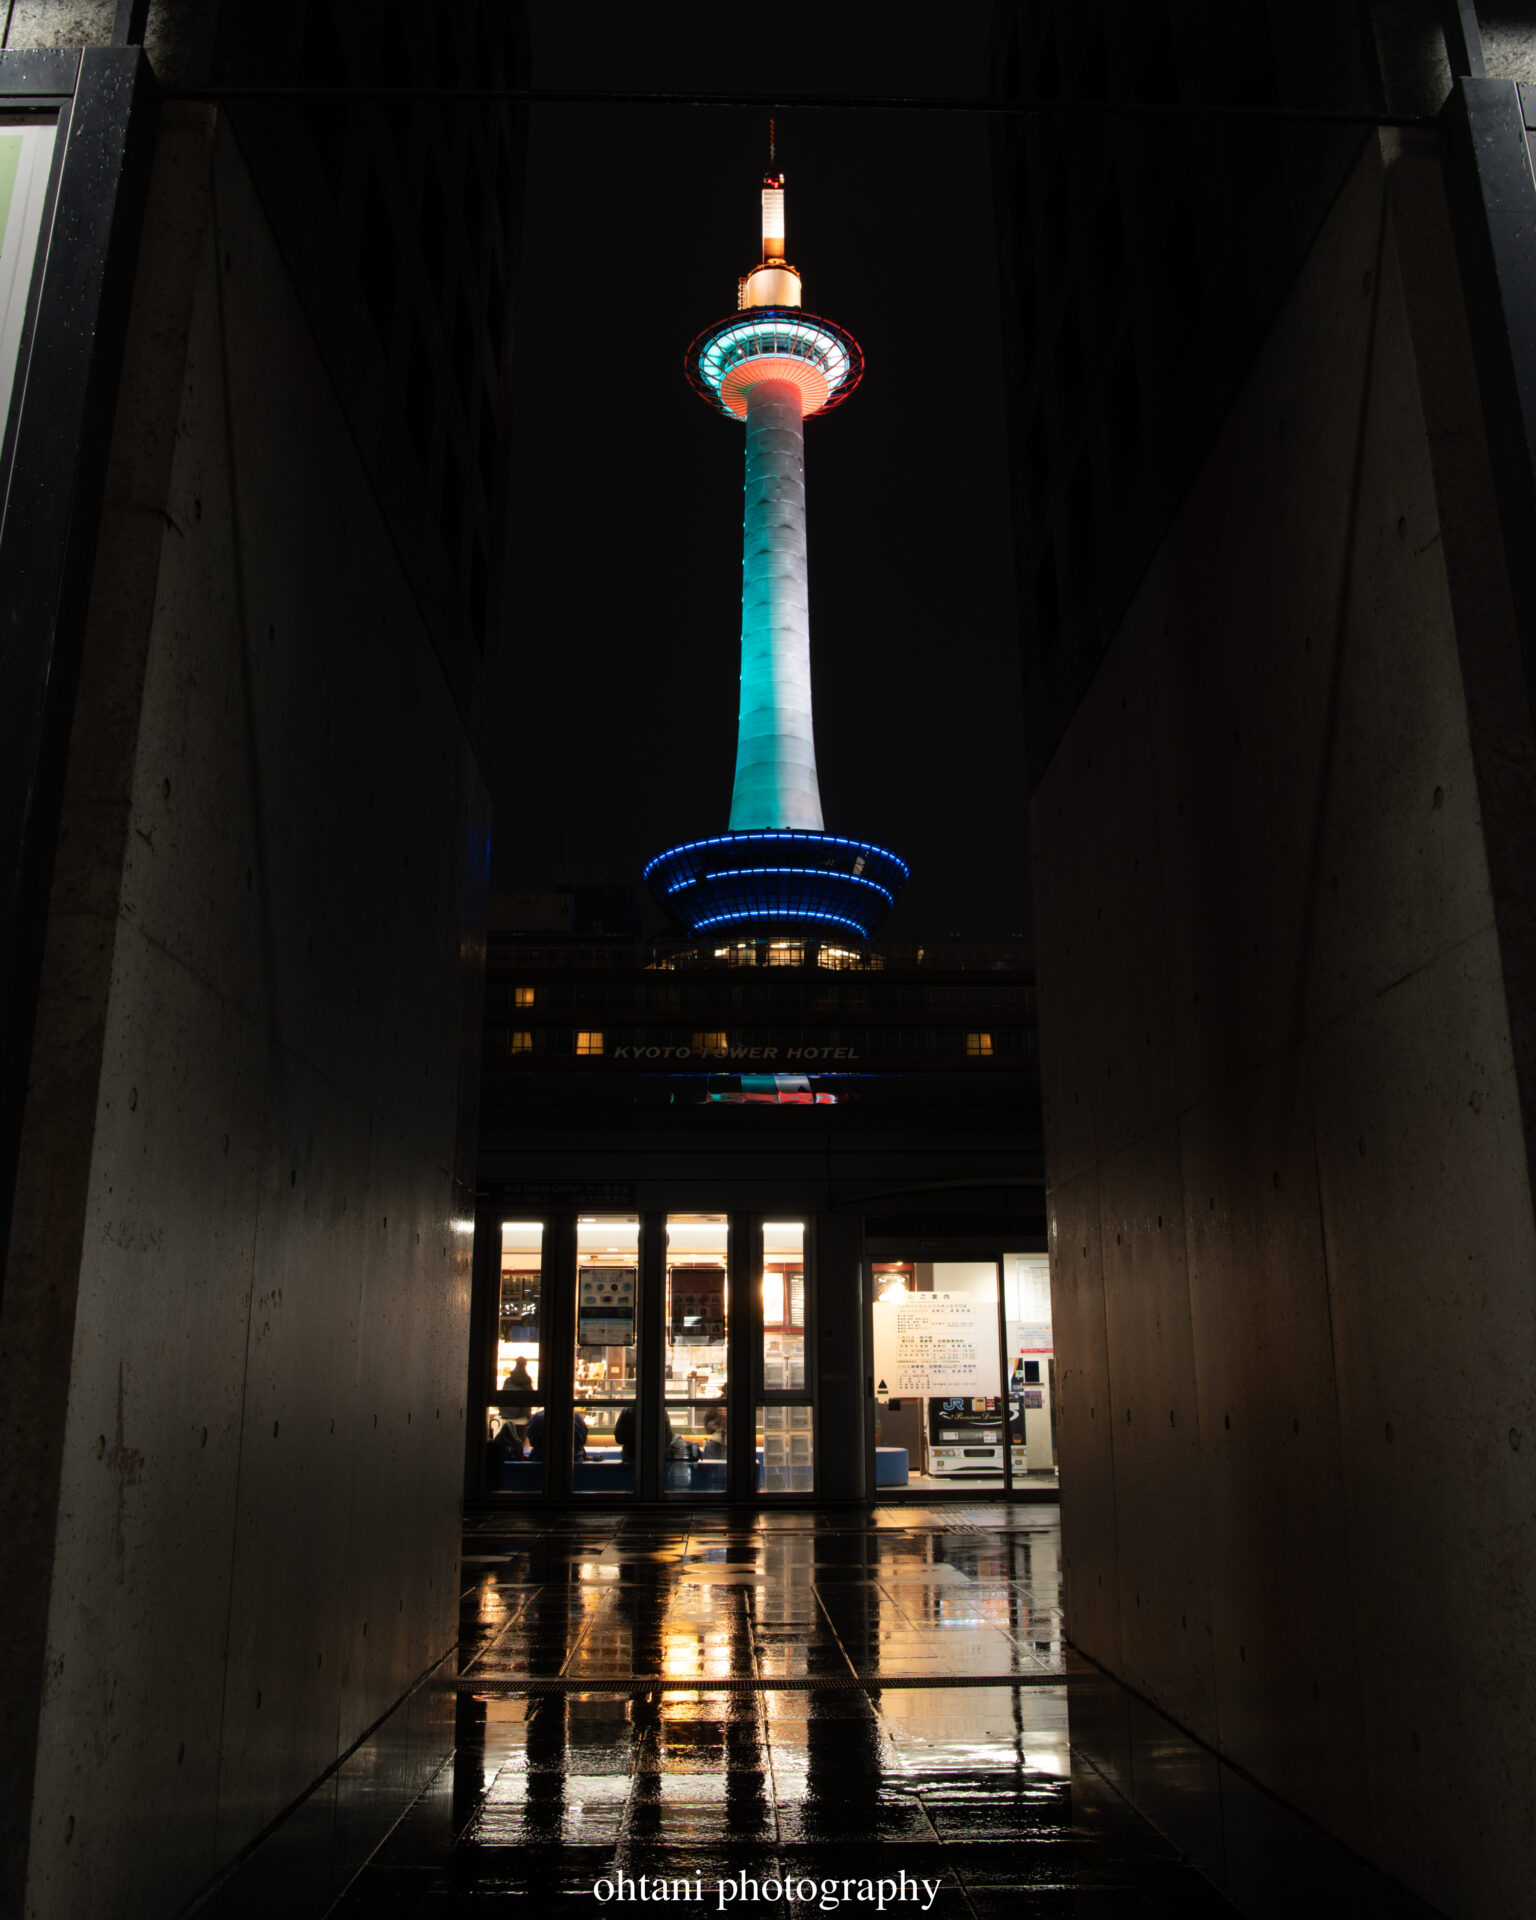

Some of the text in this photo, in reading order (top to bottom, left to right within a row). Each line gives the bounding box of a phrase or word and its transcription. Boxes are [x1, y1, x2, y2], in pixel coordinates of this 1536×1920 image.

[613, 1045, 860, 1060] KYOTO TOWER HOTEL
[943, 1397, 964, 1411] JR
